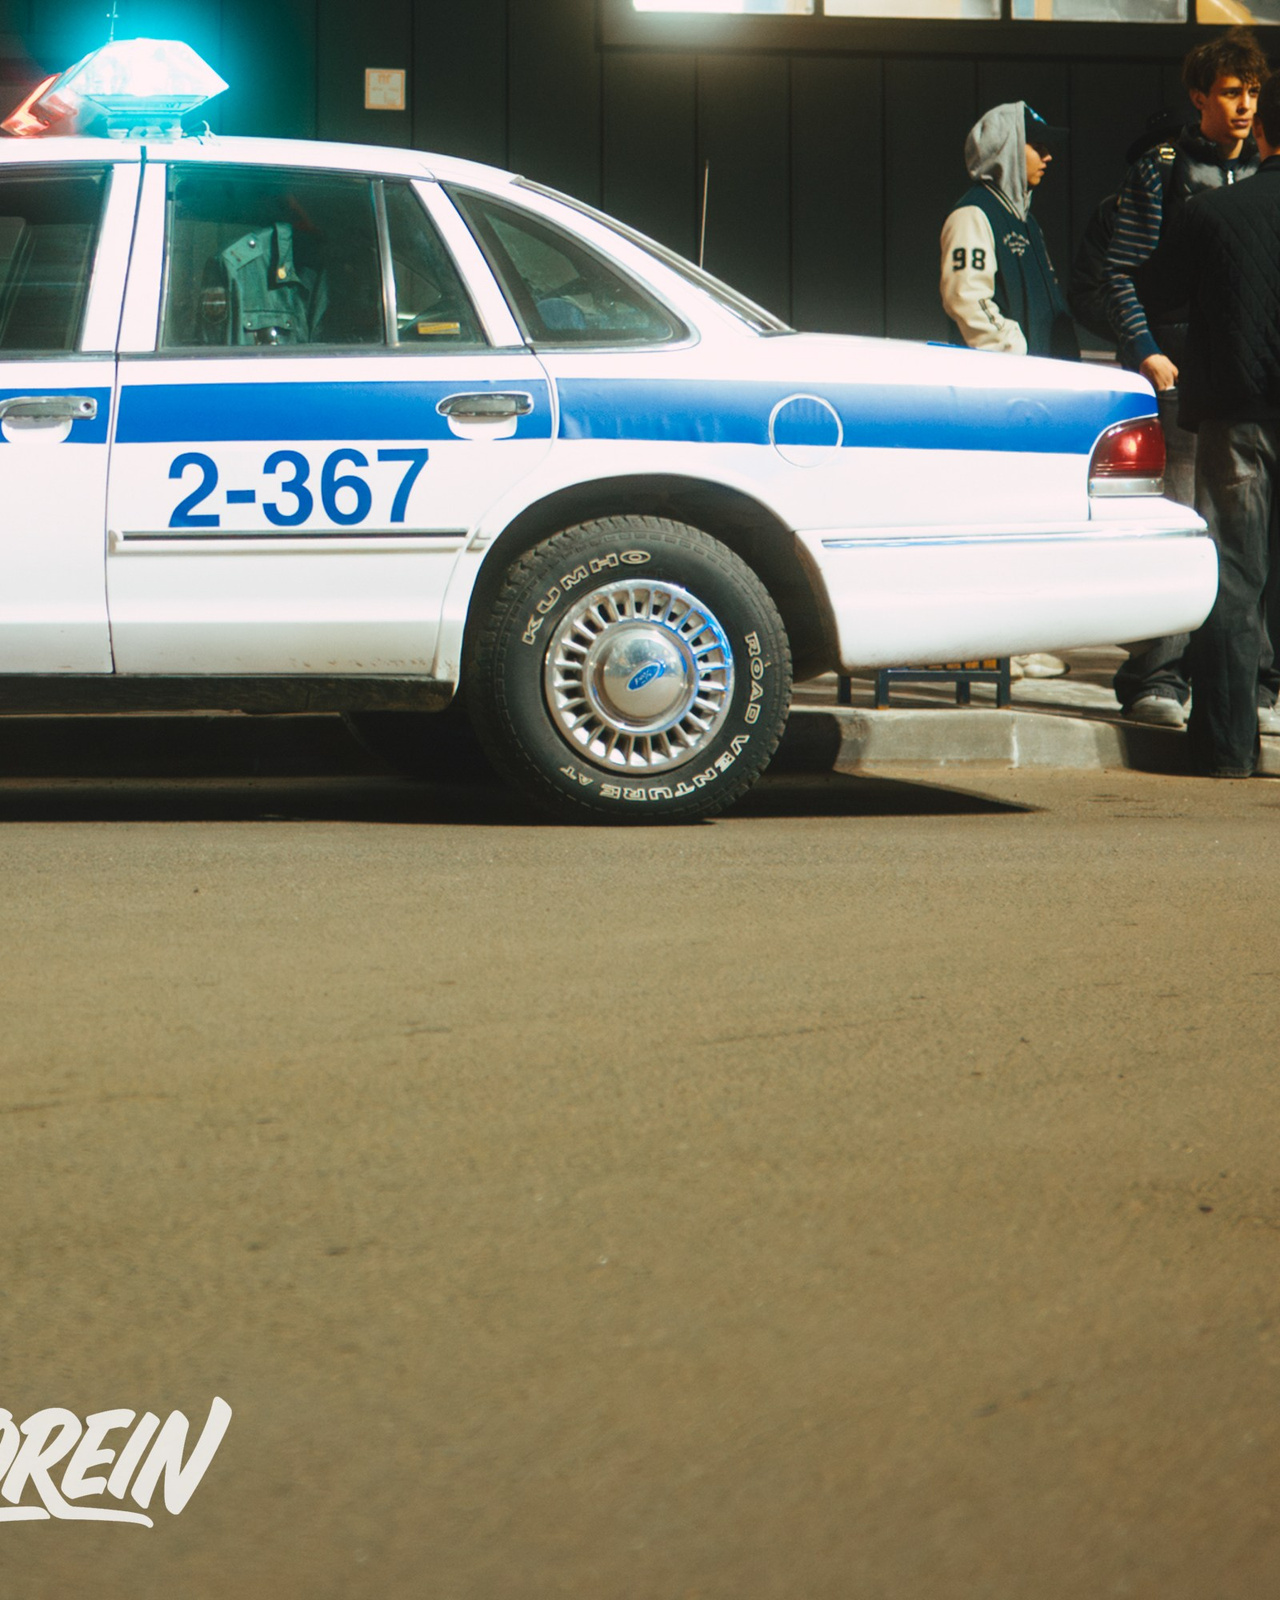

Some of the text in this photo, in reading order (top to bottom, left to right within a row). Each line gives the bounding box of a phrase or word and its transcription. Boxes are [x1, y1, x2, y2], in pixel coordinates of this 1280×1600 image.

[951, 247, 986, 271] 98
[168, 448, 429, 528] 2-367
[522, 550, 651, 645] KUMHO
[560, 631, 764, 801] ROAD VENTURE AT
